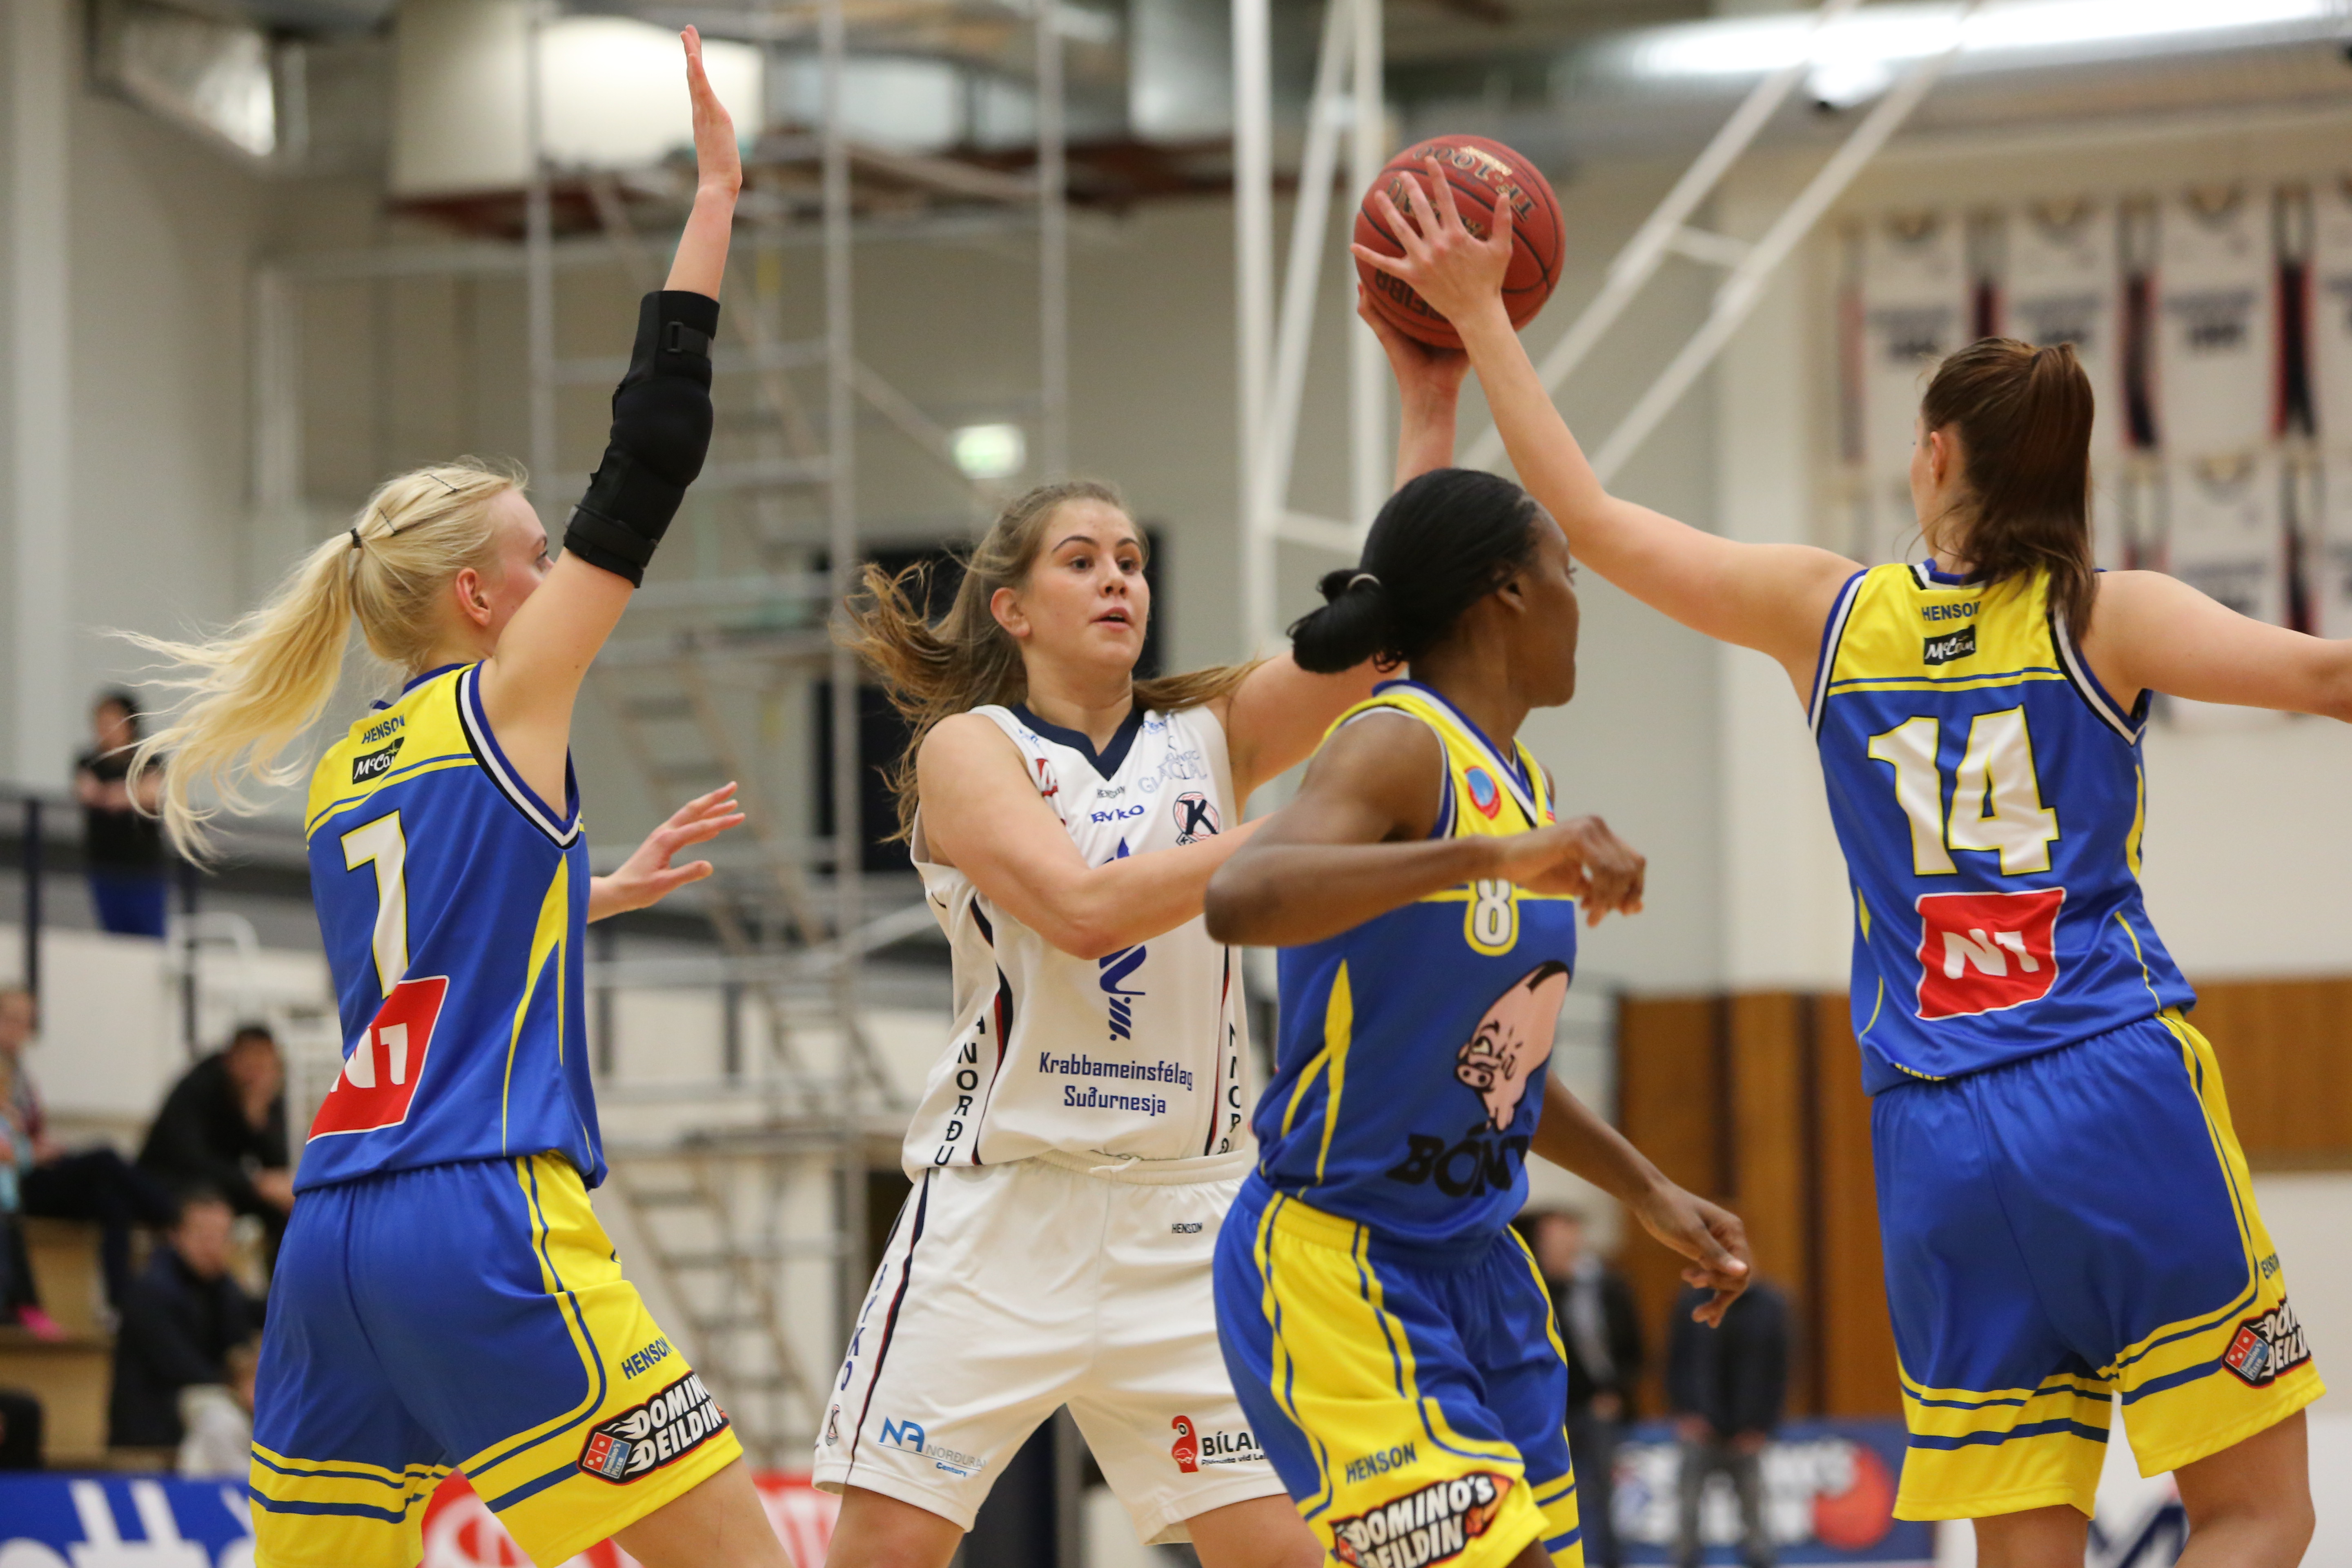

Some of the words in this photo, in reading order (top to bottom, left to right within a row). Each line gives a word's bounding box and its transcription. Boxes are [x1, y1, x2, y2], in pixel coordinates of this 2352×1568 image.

[1867, 704, 2060, 876] 14
[340, 808, 409, 999] 7
[1469, 878, 1516, 952] 8
[1942, 928, 2040, 979] N1
[1039, 1052, 1192, 1091] Krabbameinsfélag
[1064, 1085, 1165, 1116] Suðurnesja
[621, 1336, 673, 1380] HENSON
[601, 1374, 709, 1439] DOMIN
[1345, 1441, 1418, 1484] HENSON
[1335, 1475, 1496, 1551] DOMINO'S
